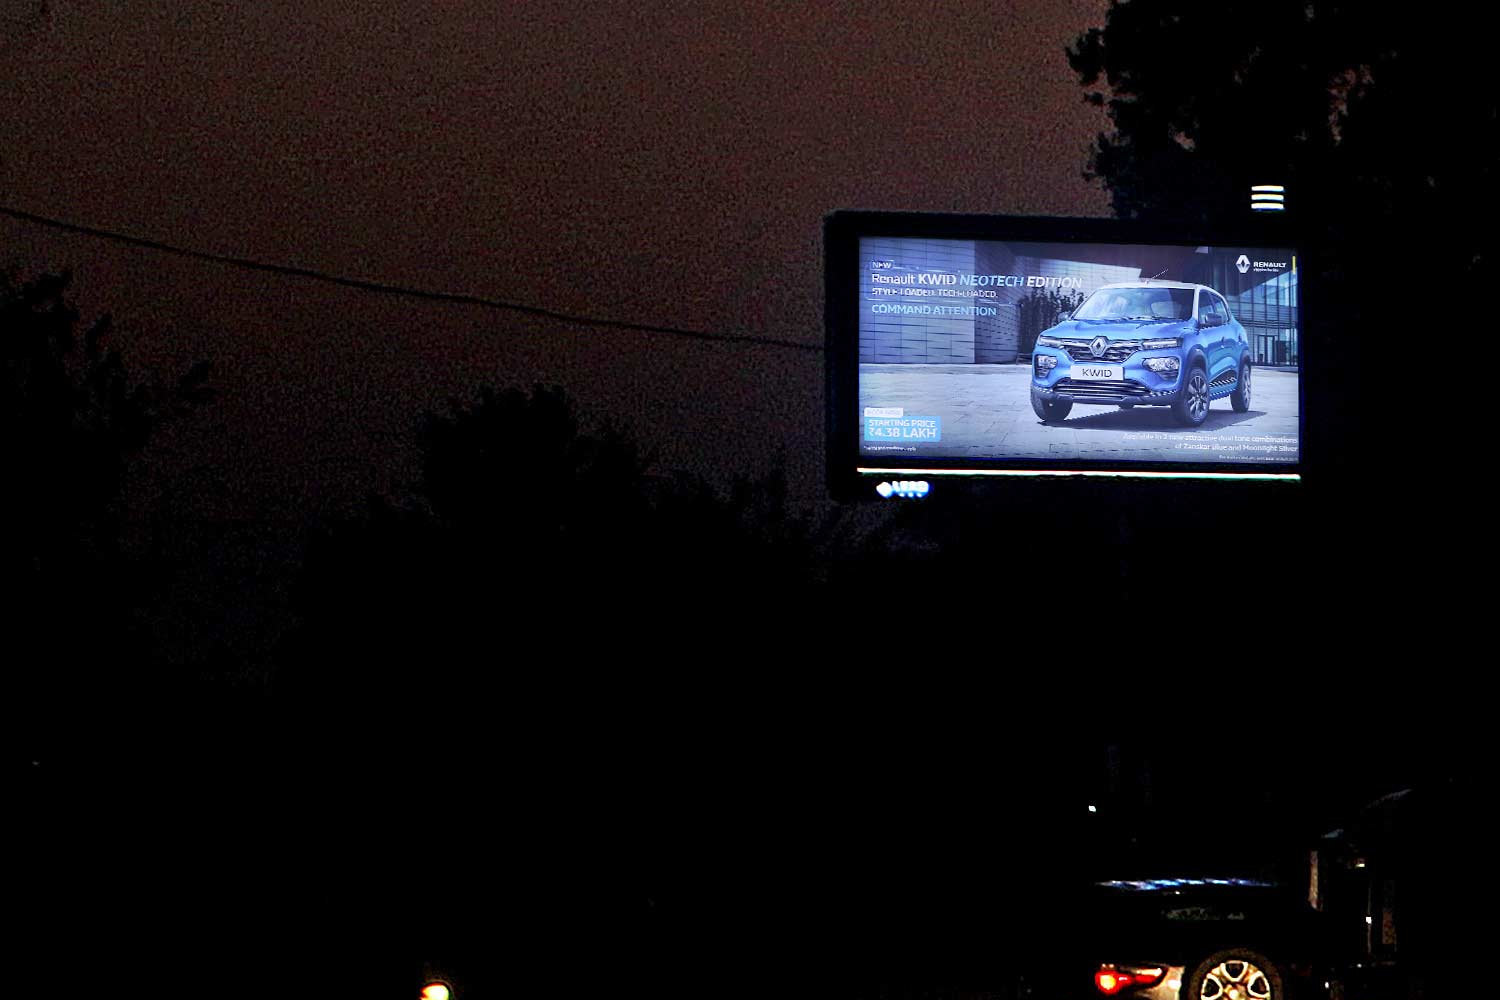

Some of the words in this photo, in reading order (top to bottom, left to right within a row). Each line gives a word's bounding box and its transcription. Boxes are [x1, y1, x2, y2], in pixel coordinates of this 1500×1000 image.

[872, 273, 916, 285] Renault
[918, 274, 957, 286] KWID
[959, 274, 1024, 287] NEOTECH
[1027, 276, 1082, 288] EDITION
[871, 304, 931, 315] COMMAND
[933, 305, 998, 316] ATTENTION
[1082, 368, 1113, 378] KWID
[868, 419, 910, 427] STARTING
[911, 420, 936, 428] PRICE
